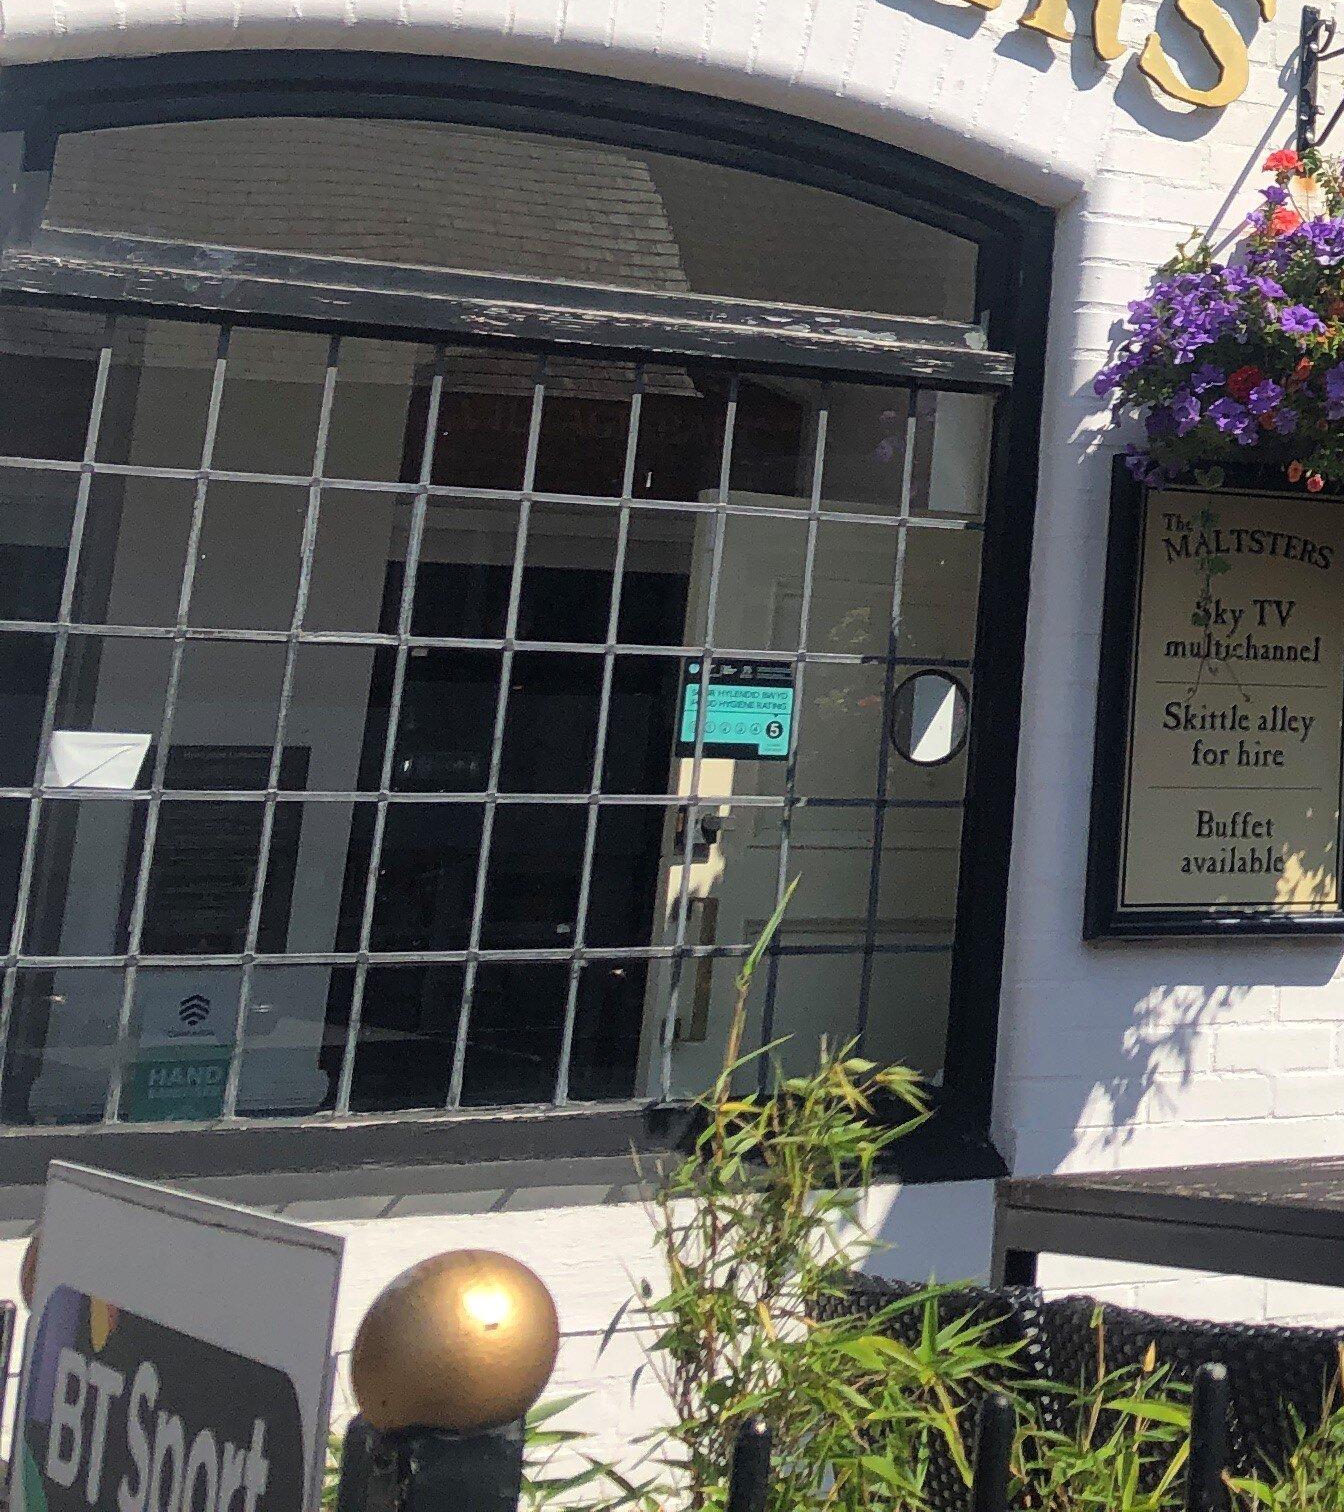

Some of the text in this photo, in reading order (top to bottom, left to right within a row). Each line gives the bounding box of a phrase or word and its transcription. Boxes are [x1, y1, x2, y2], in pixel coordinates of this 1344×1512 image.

[1162, 512, 1194, 533] The
[1161, 528, 1334, 571] MALTSTERS
[1194, 598, 1297, 639] Sky TV
[1164, 632, 1322, 664] multichannel
[769, 723, 780, 738] 5
[1162, 702, 1316, 743] Skittle alley
[1191, 738, 1286, 768] for hire
[1195, 809, 1275, 840] Buffet
[1180, 846, 1285, 875] available
[45, 1346, 270, 1512] BT Sport
